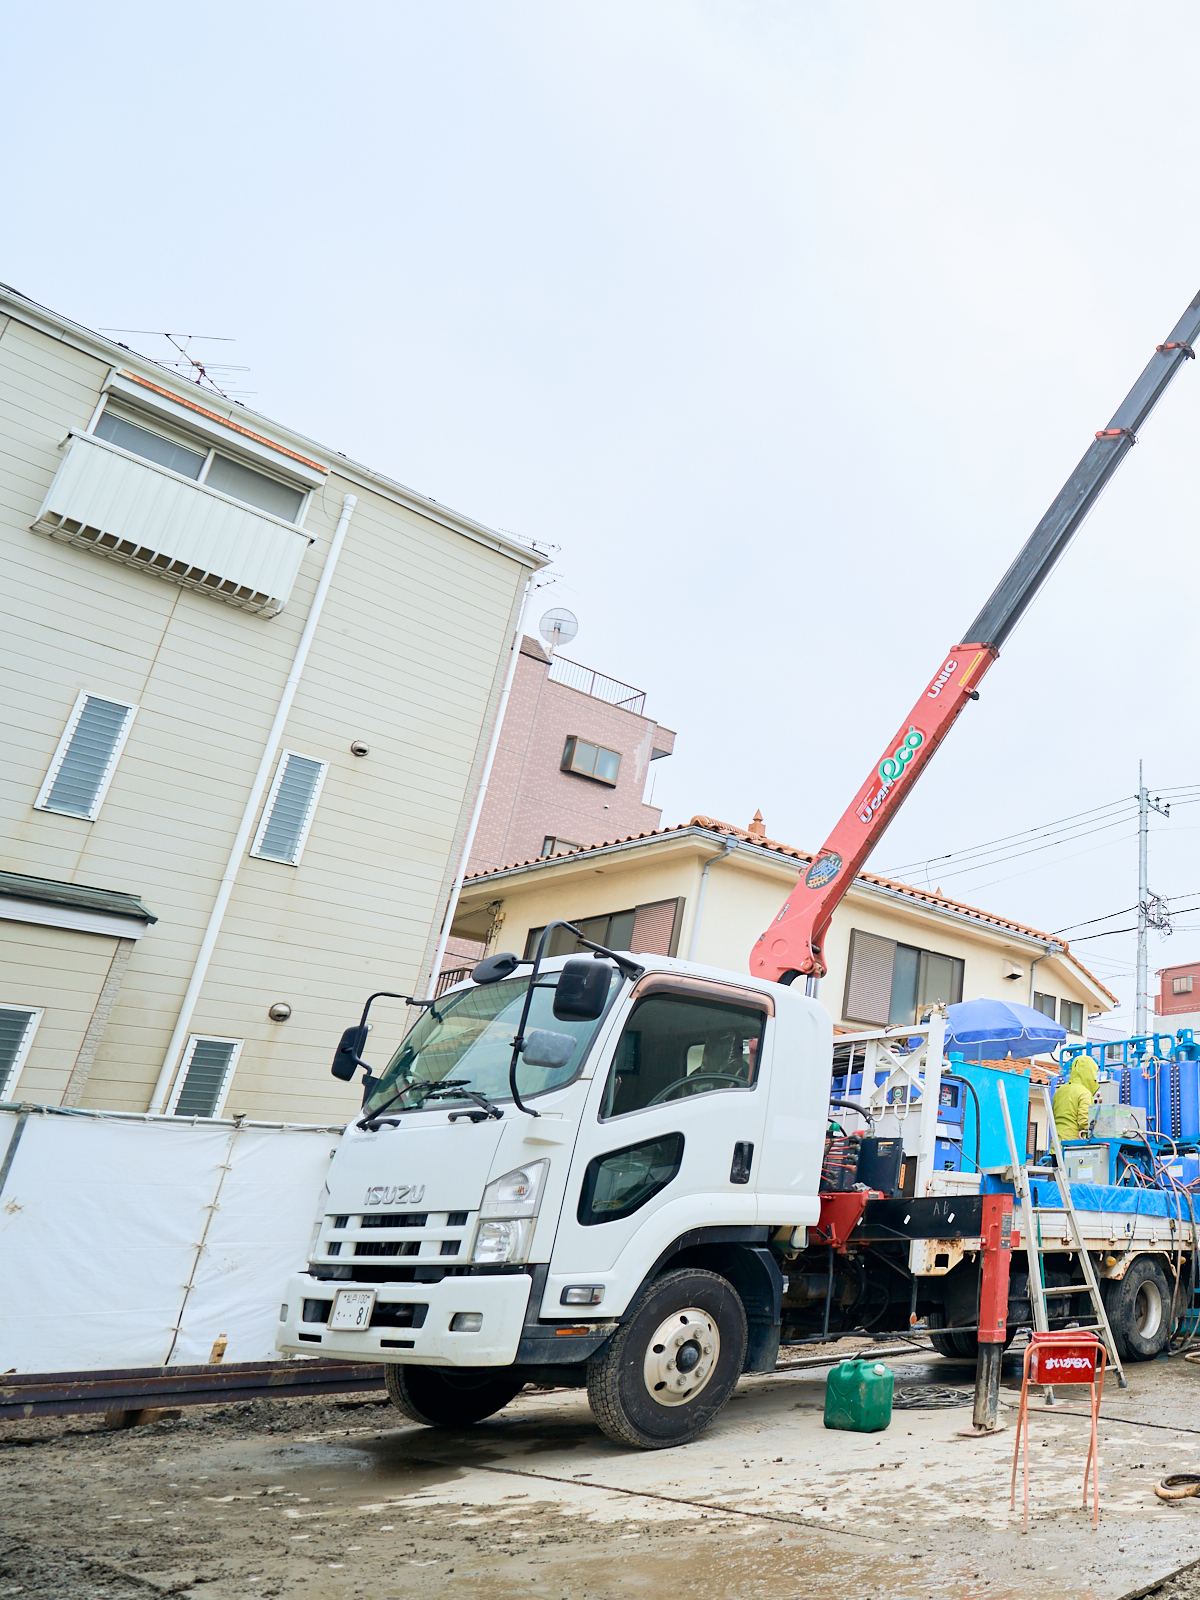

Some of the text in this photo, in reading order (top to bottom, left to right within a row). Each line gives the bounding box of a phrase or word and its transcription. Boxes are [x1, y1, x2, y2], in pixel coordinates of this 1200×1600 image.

[926, 659, 959, 699] UNIC
[363, 1184, 426, 1206] ISUZU
[1045, 1357, 1092, 1370] すいがら入
